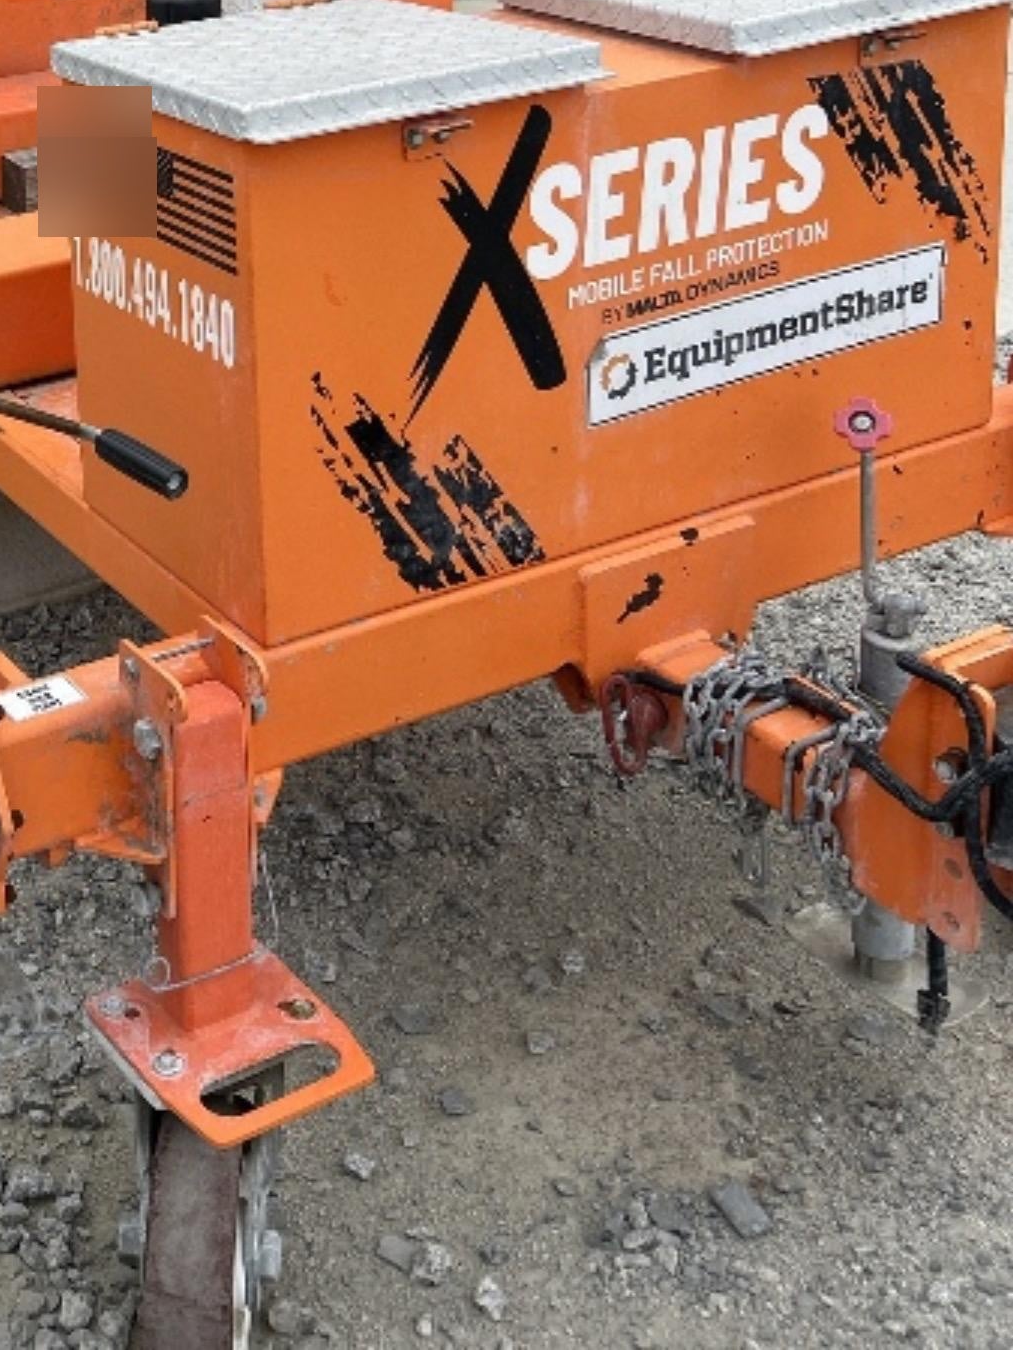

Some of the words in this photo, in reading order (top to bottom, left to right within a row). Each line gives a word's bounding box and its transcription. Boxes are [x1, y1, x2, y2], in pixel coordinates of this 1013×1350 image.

[526, 103, 830, 282] SERIES
[73, 237, 236, 369] 1.800.494.1840
[568, 266, 646, 310] MOBILE
[649, 254, 703, 287] FALL
[706, 219, 829, 271] PROTECTION
[601, 306, 625, 324] BY
[686, 261, 781, 301] DYNAMICS
[643, 280, 930, 386] EquipmentShare
